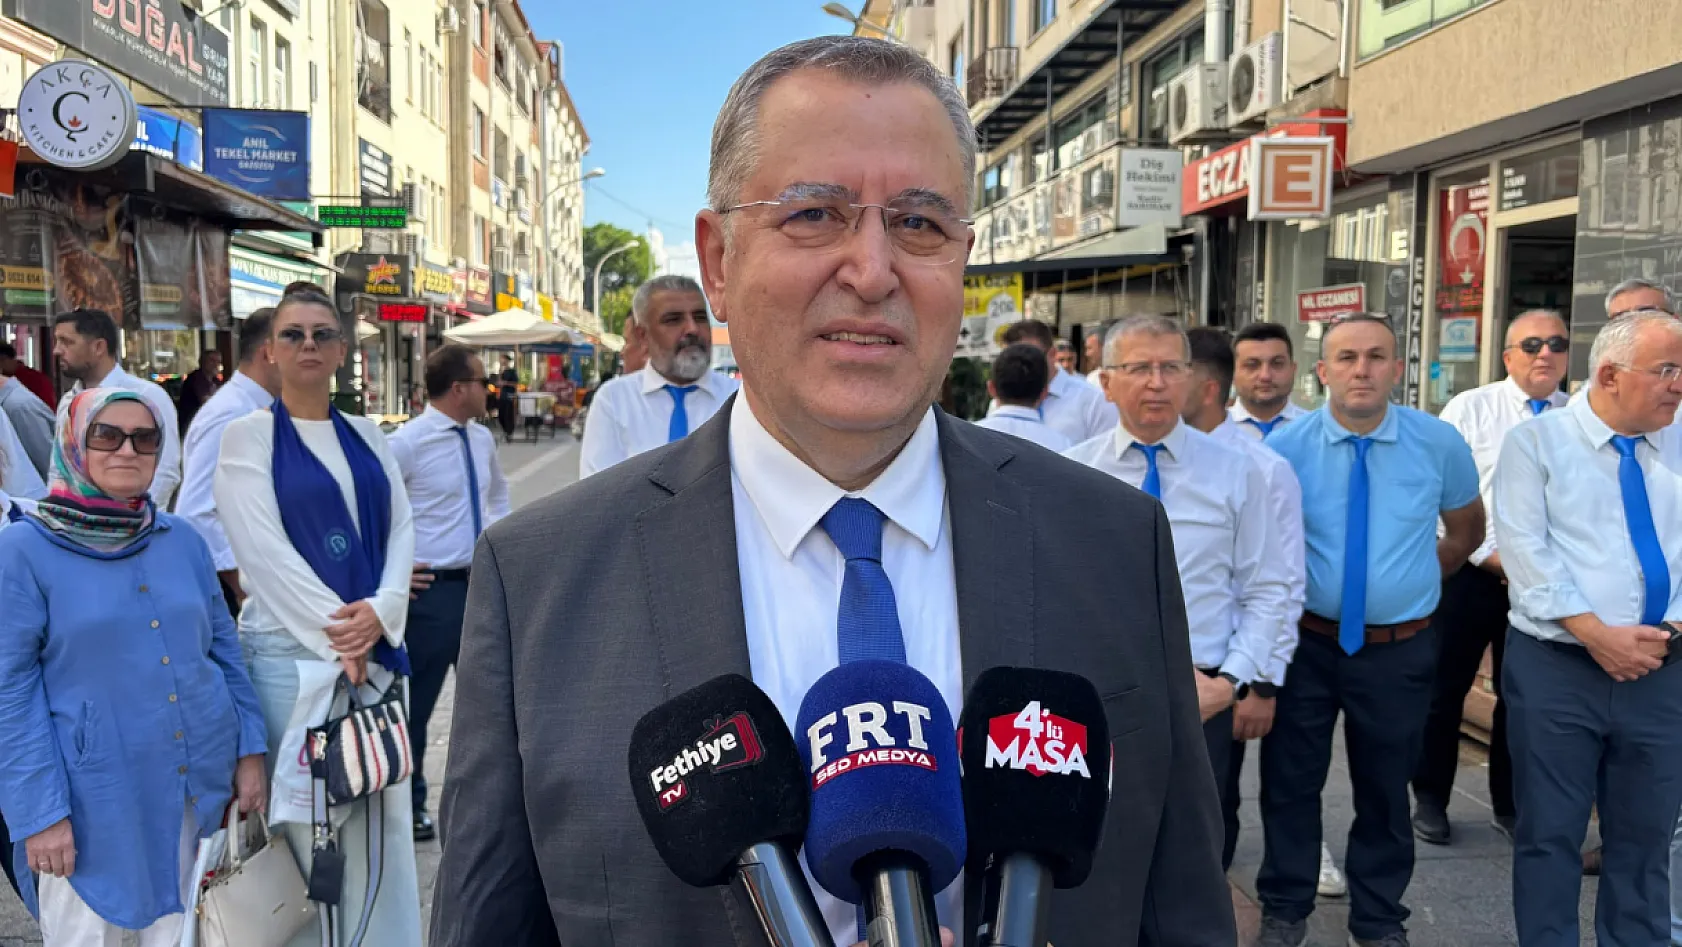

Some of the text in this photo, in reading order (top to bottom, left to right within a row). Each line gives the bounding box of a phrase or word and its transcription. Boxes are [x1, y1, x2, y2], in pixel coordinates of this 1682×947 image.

[40, 66, 112, 99] AKÇA
[214, 147, 297, 163] TEKEL MARKET
[1126, 171, 1177, 184] Hekimi
[1198, 144, 1251, 204] ECZA
[808, 700, 932, 774] FRT
[650, 732, 738, 793] Fethiye
[856, 750, 932, 770] MEDYA
[984, 734, 1092, 779] MASA
[662, 784, 683, 804] TV
